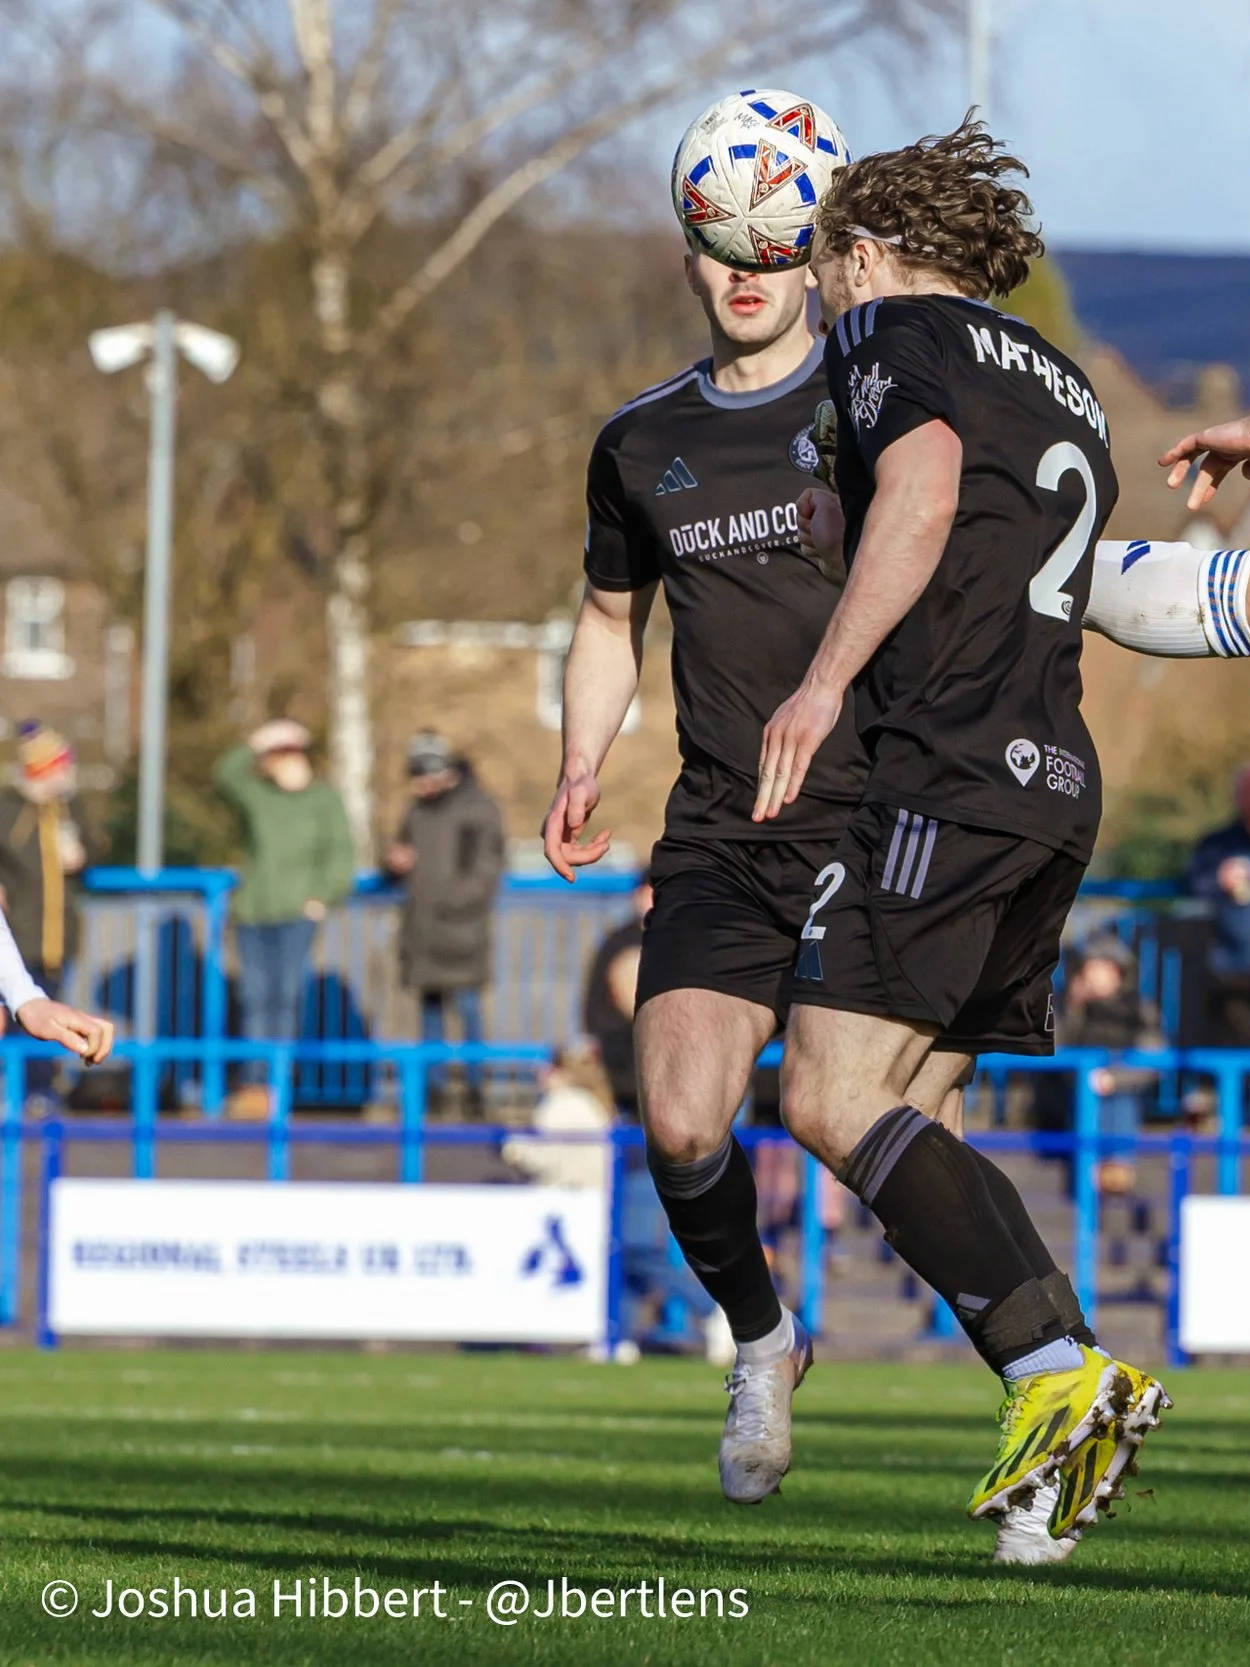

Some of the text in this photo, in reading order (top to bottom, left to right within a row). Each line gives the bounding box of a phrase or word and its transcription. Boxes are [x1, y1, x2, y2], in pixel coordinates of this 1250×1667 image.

[966, 323, 1109, 449] MATHESON
[728, 508, 769, 545] AND
[1029, 441, 1097, 623] 2
[1043, 744, 1059, 756] THE
[1046, 773, 1080, 799] GROUP
[801, 862, 847, 940] 2
